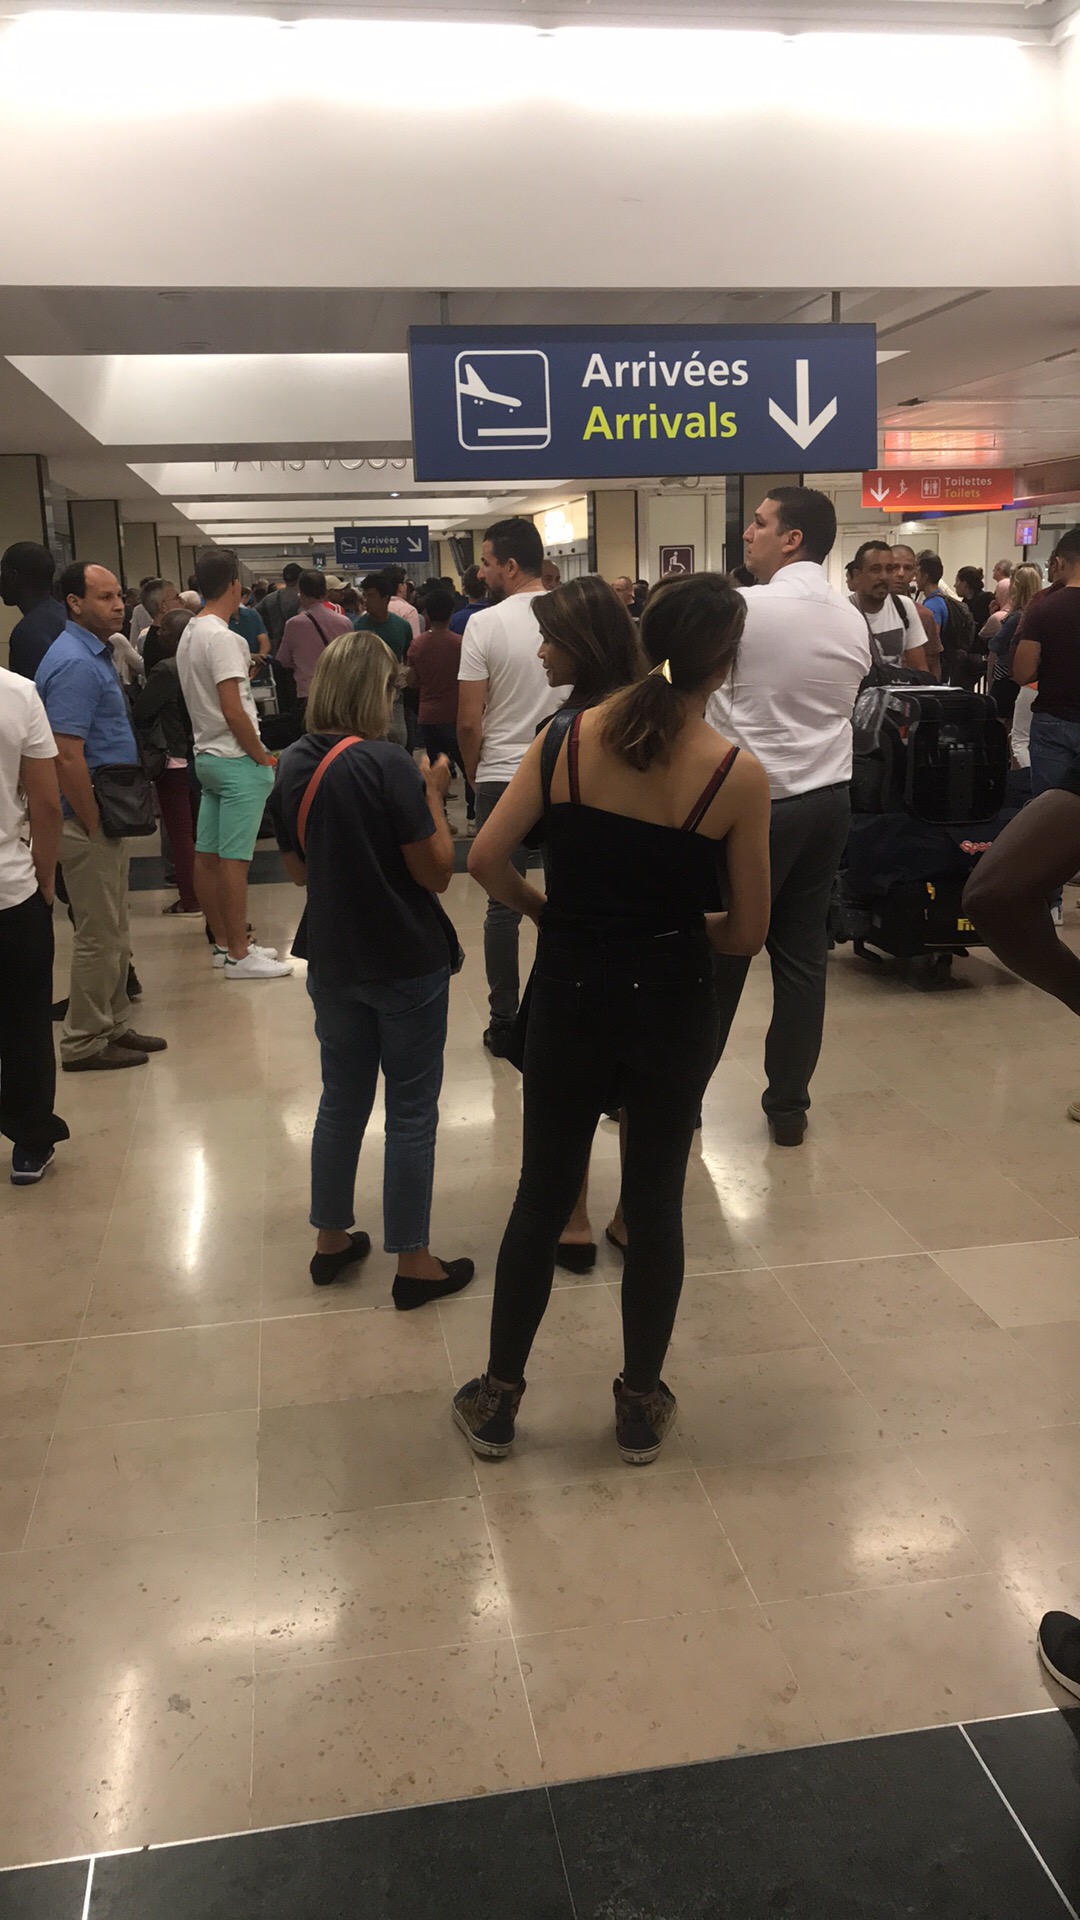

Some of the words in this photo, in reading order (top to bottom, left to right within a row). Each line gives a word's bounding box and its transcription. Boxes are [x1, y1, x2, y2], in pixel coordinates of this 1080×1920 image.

[581, 351, 749, 388] Arrivées
[582, 401, 738, 440] Arrivals
[944, 476, 992, 487] Toilettes
[944, 488, 981, 498] Toilets
[360, 535, 400, 545] Arrivées
[361, 545, 398, 554] Arrivals
